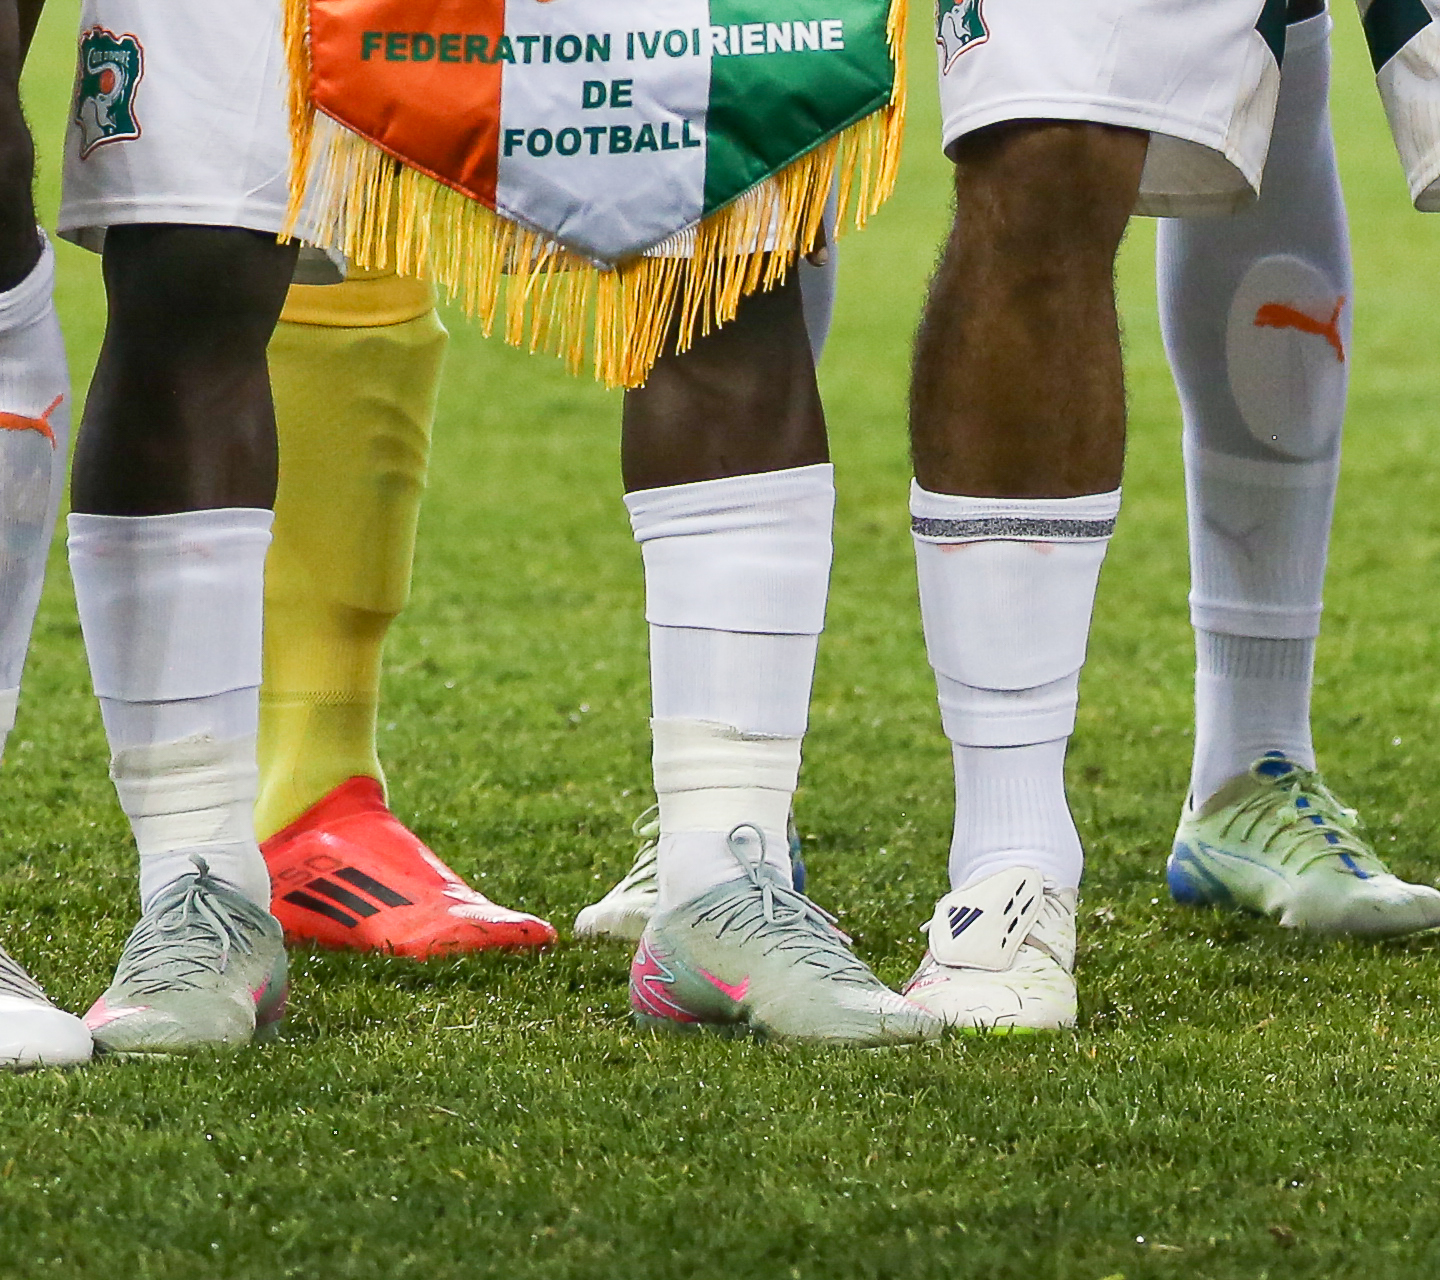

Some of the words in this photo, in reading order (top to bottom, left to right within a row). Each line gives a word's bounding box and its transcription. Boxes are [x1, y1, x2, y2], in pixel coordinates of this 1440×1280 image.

[361, 30, 612, 64] FEDERATION
[625, 19, 846, 62] IVOIRIENNE
[581, 79, 634, 110] DE
[503, 118, 702, 158] FOOTBALL
